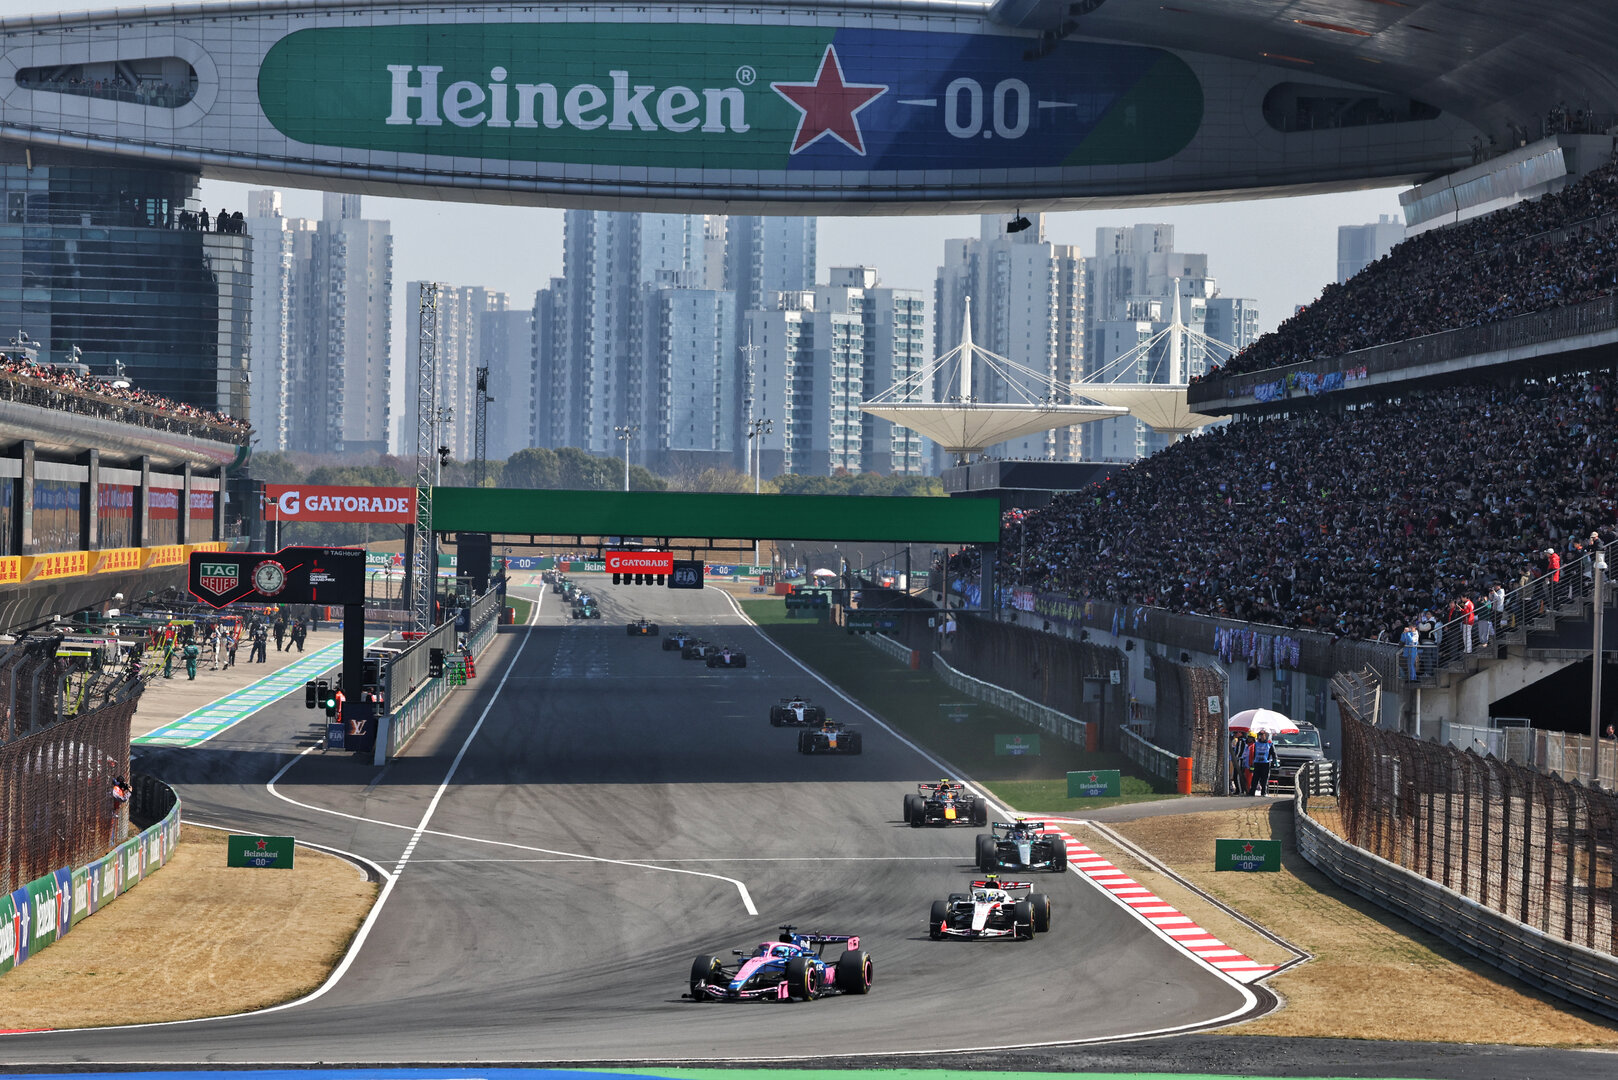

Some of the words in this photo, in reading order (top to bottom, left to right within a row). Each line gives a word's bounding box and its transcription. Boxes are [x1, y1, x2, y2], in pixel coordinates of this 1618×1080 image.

[945, 77, 1031, 139] 0.0
[304, 496, 409, 513] GATORADE
[622, 559, 669, 567] GATORADE
[203, 565, 236, 576] TAG
[202, 577, 237, 594] HEUER
[243, 849, 278, 858] Heineken
[1231, 853, 1265, 861] Heineken
